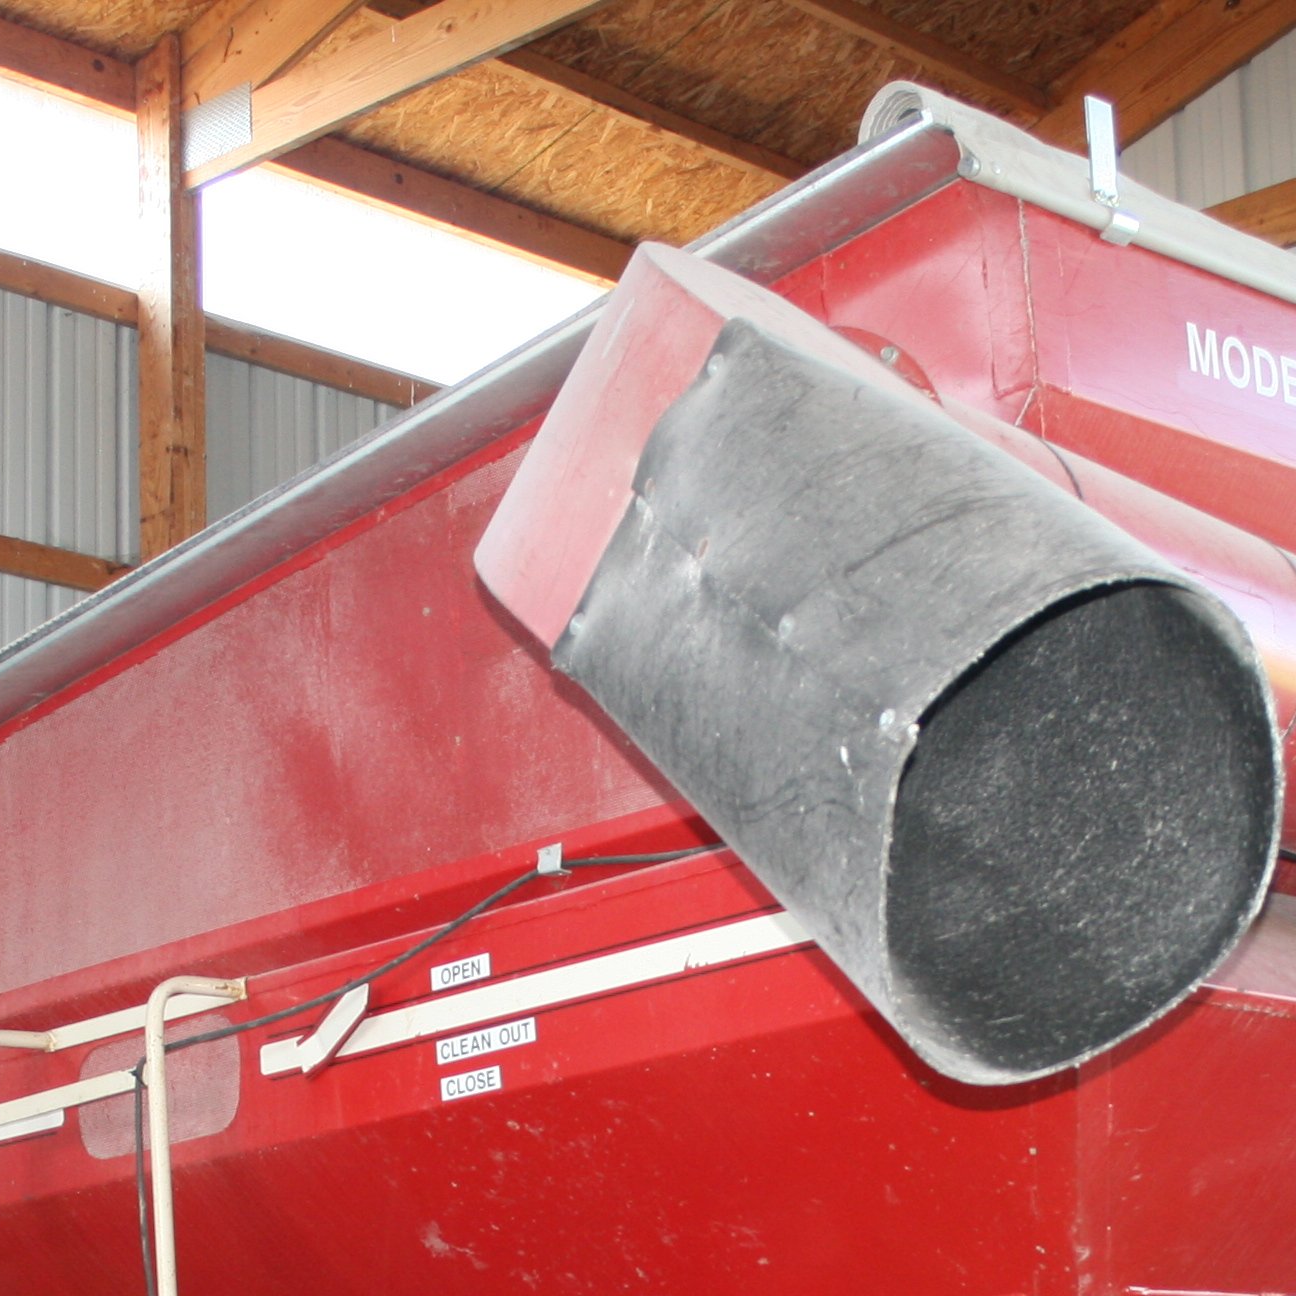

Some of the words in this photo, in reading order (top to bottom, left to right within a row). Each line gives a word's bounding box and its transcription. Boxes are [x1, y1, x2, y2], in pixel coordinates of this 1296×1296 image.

[440, 958, 482, 985] OPEN
[440, 1032, 492, 1060] CLEAN
[499, 1021, 531, 1045] OUT
[446, 1069, 497, 1097] CLOSE
